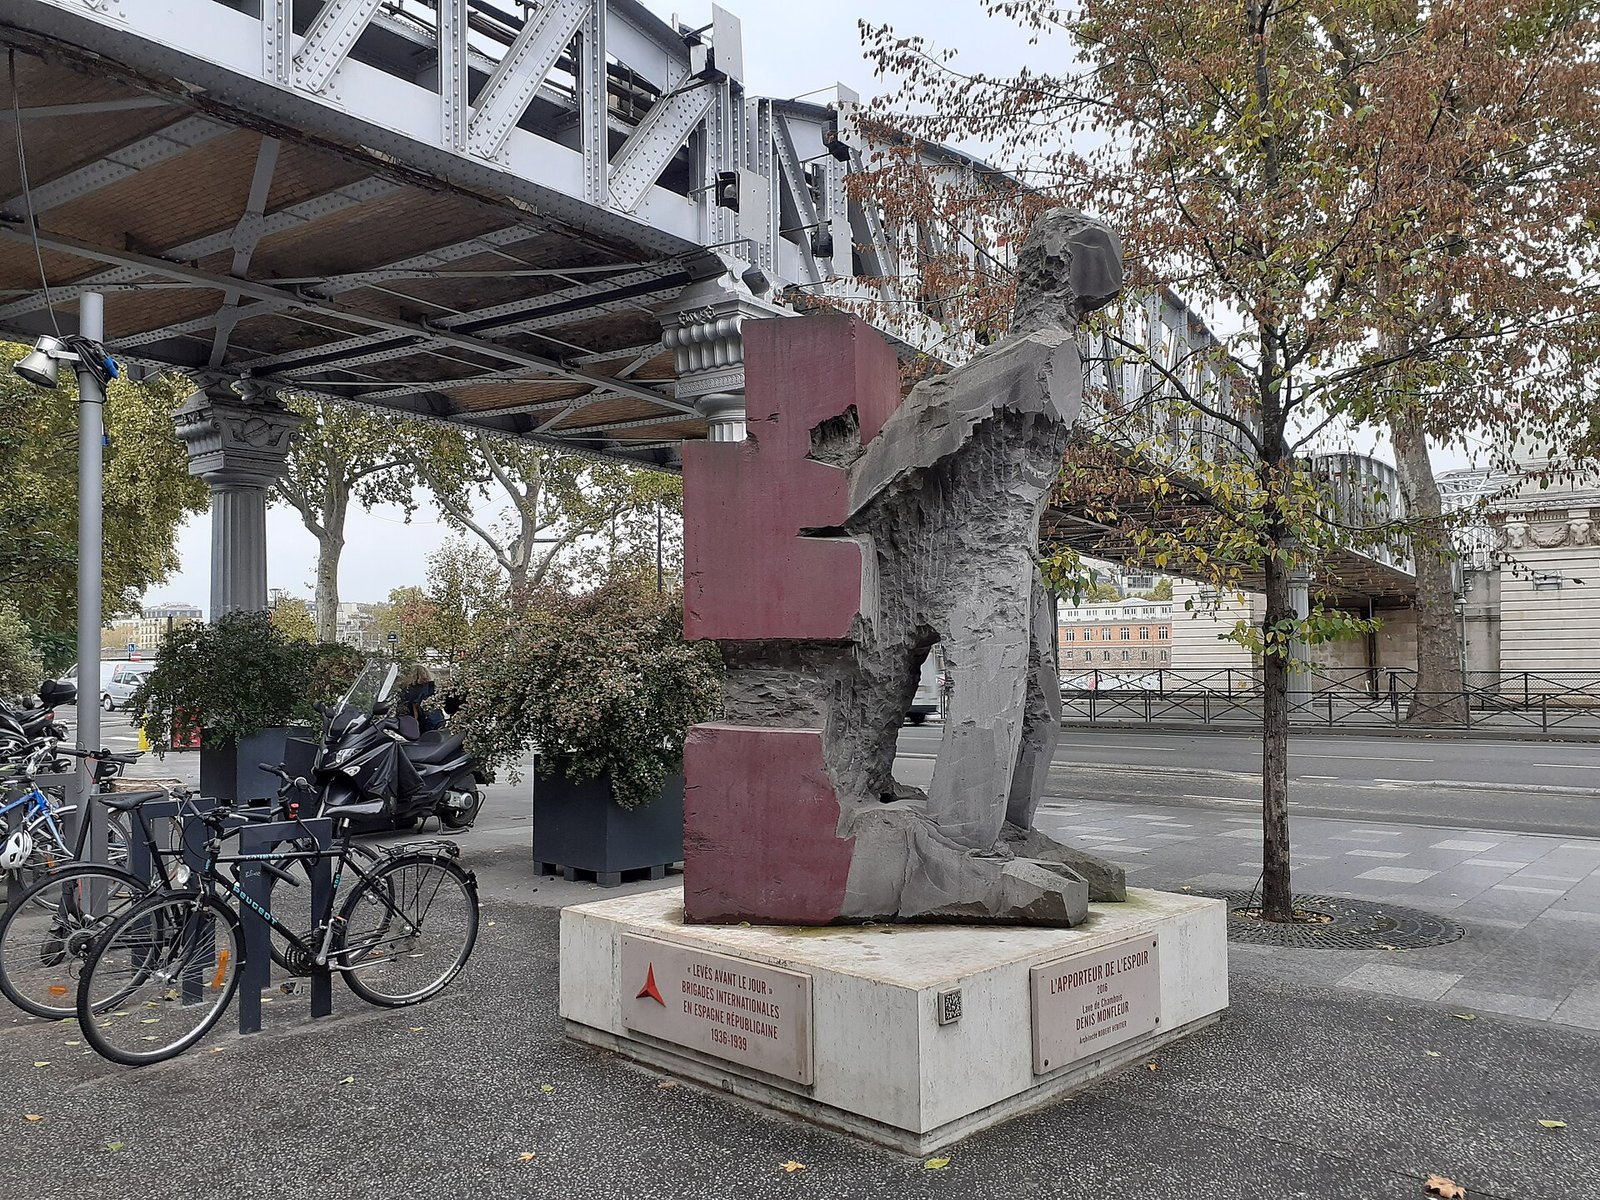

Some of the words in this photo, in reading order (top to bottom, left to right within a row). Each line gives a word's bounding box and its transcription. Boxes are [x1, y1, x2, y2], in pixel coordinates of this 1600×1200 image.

[693, 964, 713, 981] LEVÉS
[715, 969, 736, 987] AVANT
[738, 975, 747, 990] LE
[748, 977, 766, 995] JOUR
[1050, 964, 1103, 995] L'APPORTEUR
[1105, 961, 1115, 978] DE
[1117, 950, 1149, 974] L'ESPOIR
[681, 980, 714, 1001] BRIGADES
[716, 989, 780, 1019] INTERNATIONALES
[1094, 1000, 1100, 1010] de
[683, 1000, 692, 1014] EN
[694, 1003, 724, 1024] ESPAGNE
[726, 1011, 778, 1040] RÉPUBLICAINE
[1076, 1013, 1096, 1031] DENIS
[1097, 1001, 1130, 1023] MONFLEUR
[710, 1028, 747, 1051] 1936-1939
